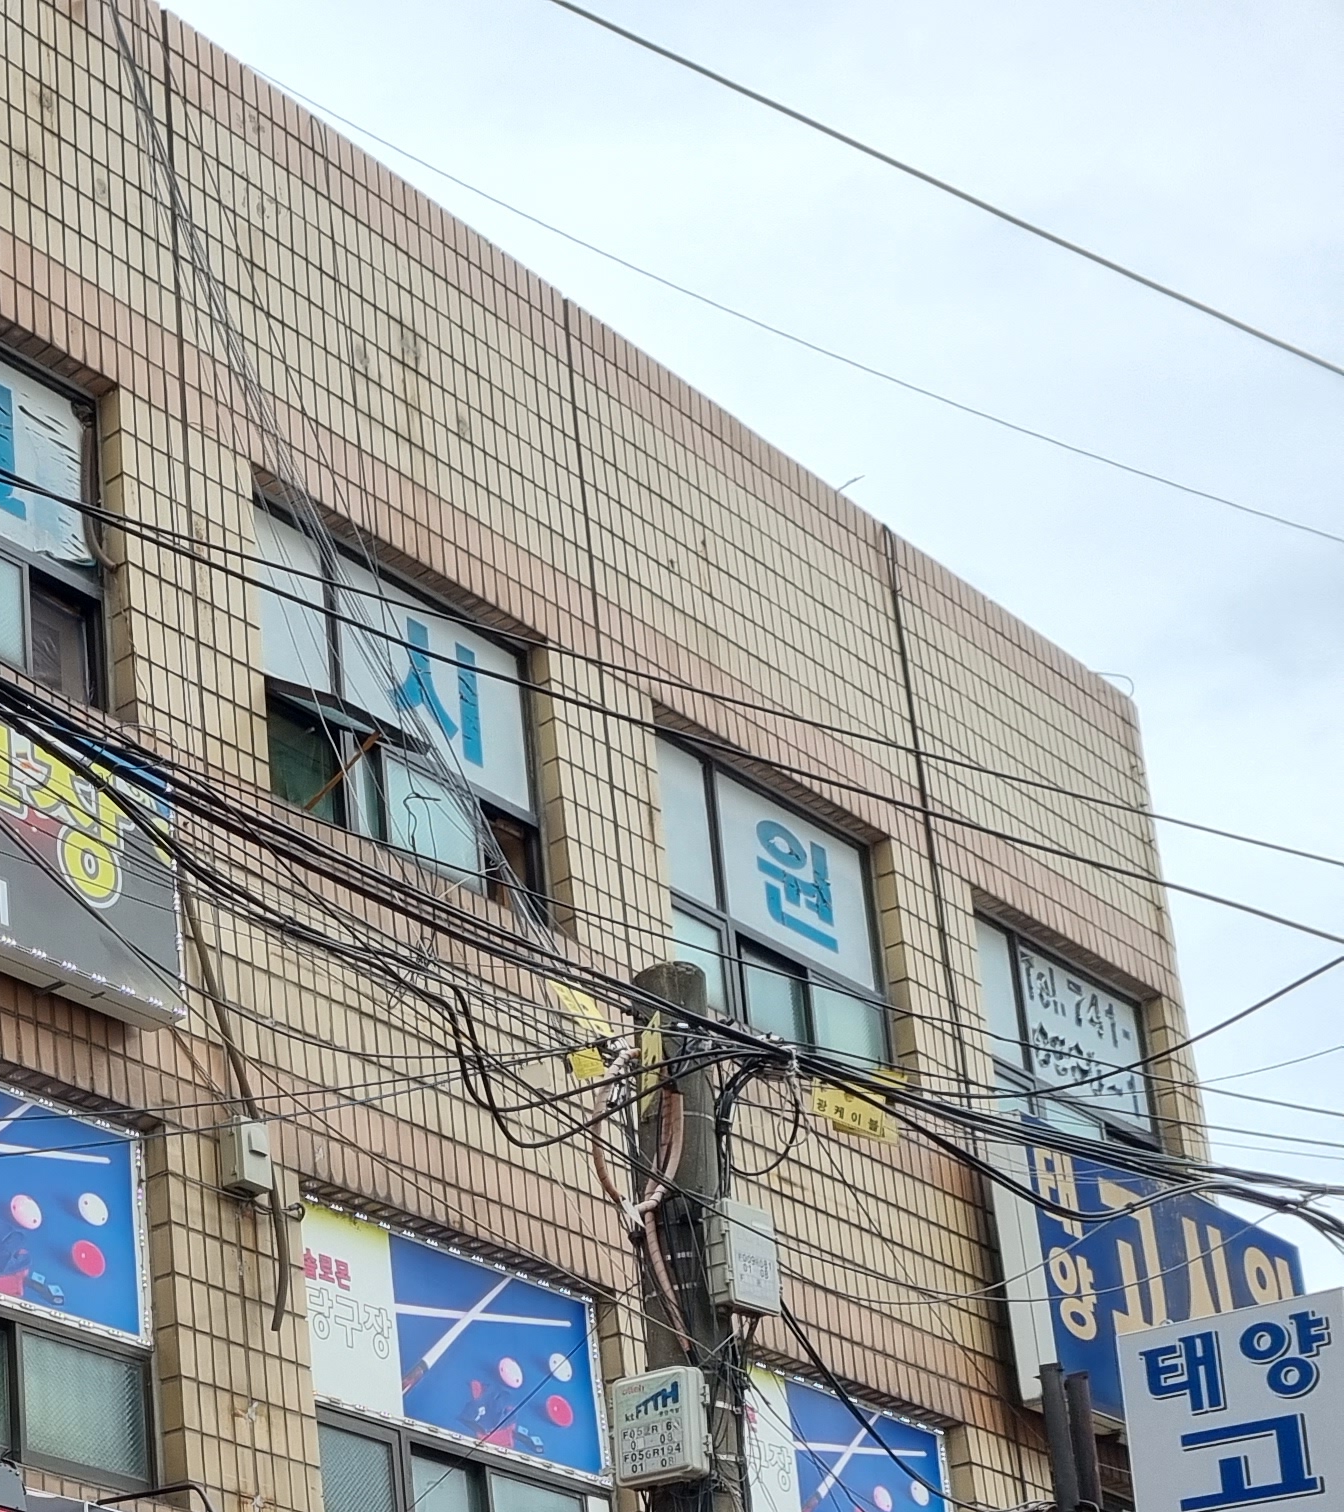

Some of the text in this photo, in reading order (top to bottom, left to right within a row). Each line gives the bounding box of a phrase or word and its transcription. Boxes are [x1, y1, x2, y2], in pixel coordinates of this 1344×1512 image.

[388, 616, 484, 767] 시
[756, 818, 840, 954] 원
[816, 1096, 881, 1132] 광케이블
[1034, 1147, 1097, 1341] 태양
[635, 1380, 680, 1420] FTTH
[1140, 1310, 1332, 1415] 태양
